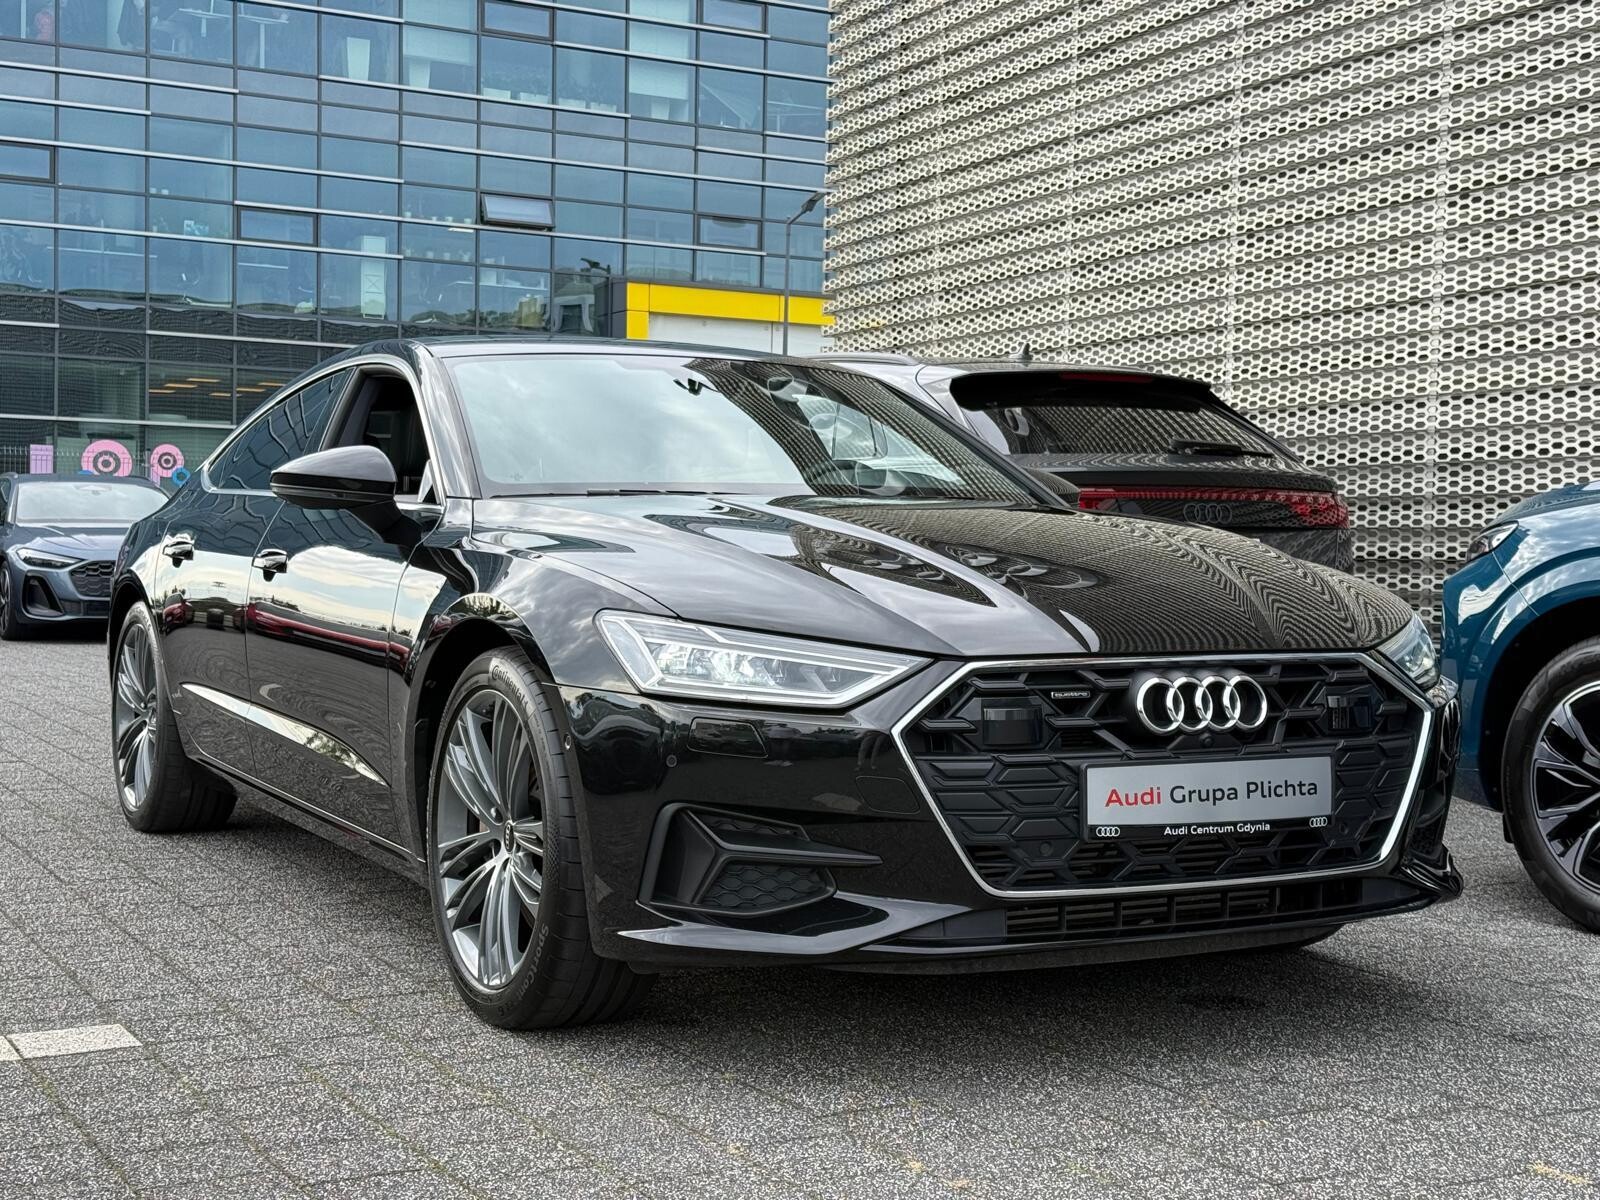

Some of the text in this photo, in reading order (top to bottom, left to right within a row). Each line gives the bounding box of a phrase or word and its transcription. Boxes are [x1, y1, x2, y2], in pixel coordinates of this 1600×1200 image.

[1104, 779, 1318, 808] Audi Grupa Plichta
[1163, 822, 1271, 836] Audi Centrum Gdynia
